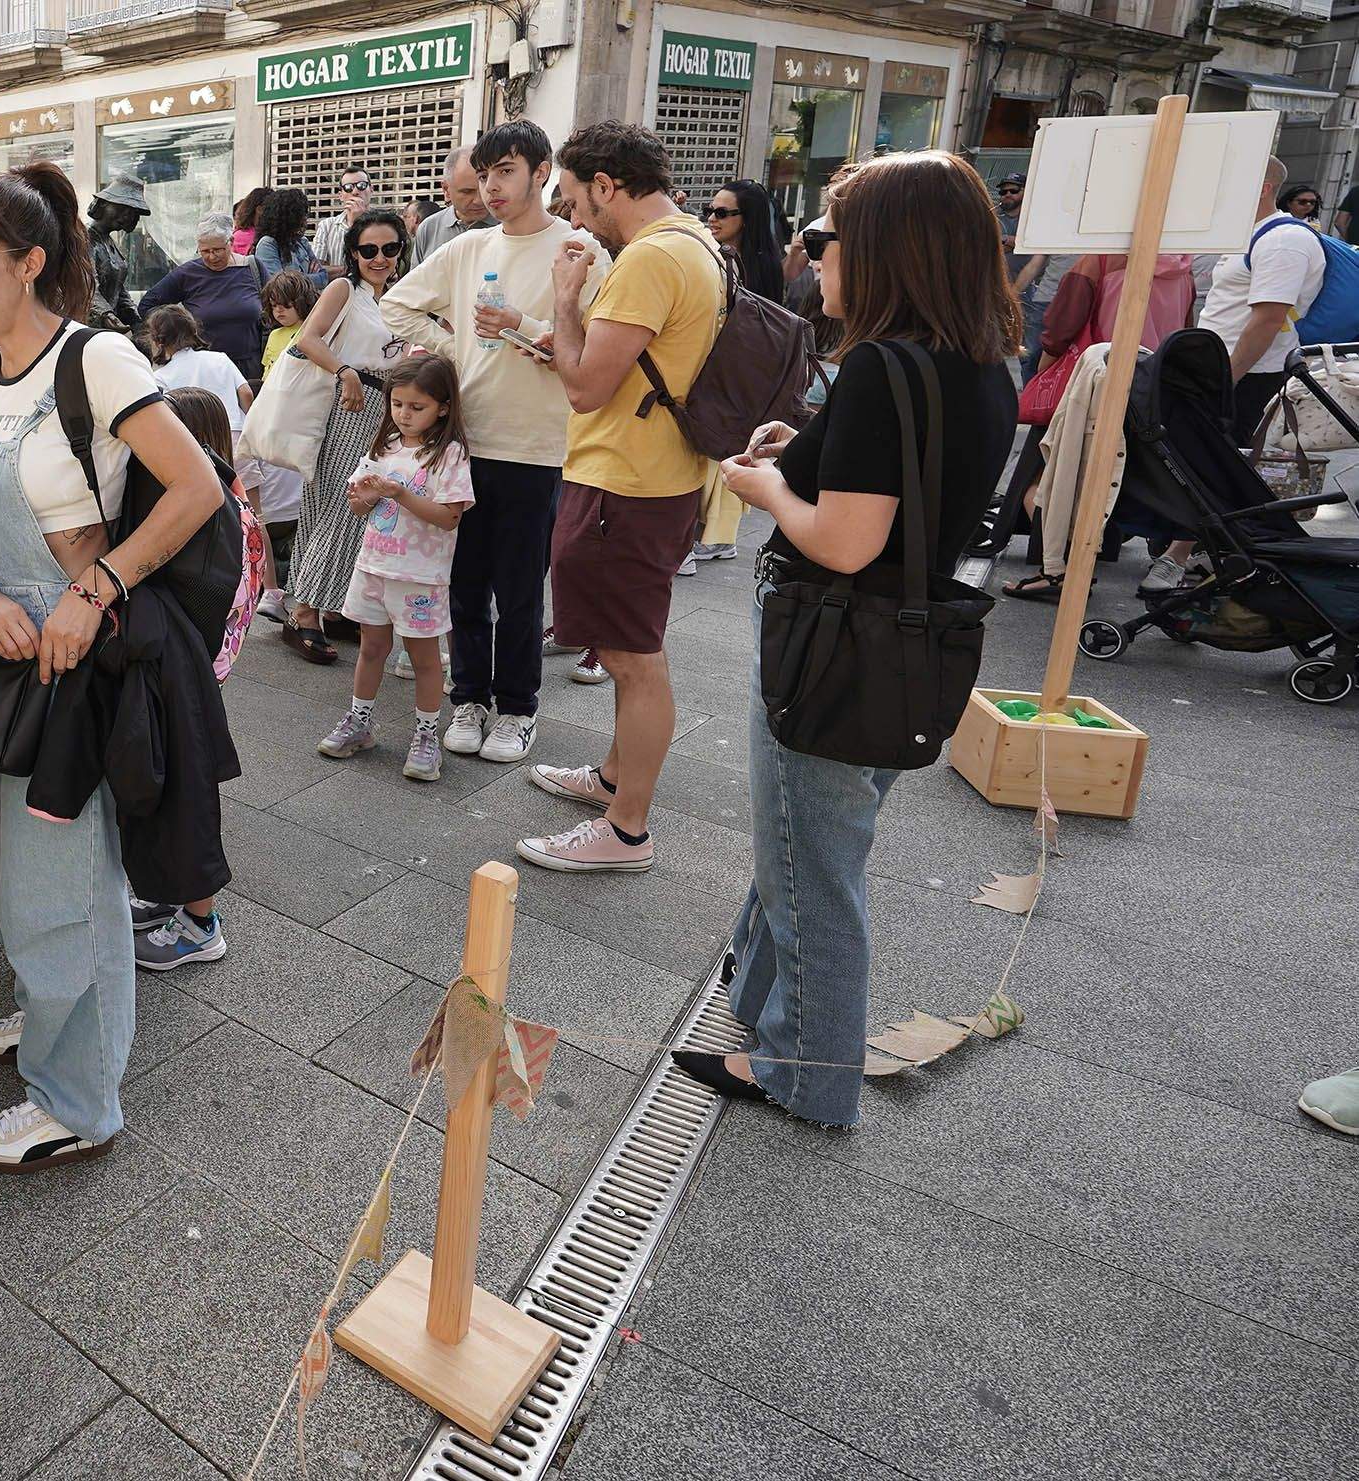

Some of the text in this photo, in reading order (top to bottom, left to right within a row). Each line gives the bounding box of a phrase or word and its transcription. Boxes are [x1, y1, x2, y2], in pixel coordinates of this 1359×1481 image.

[264, 36, 462, 92] HOGAR TEXTIL
[664, 43, 752, 80] HOGAR TEXTIL
